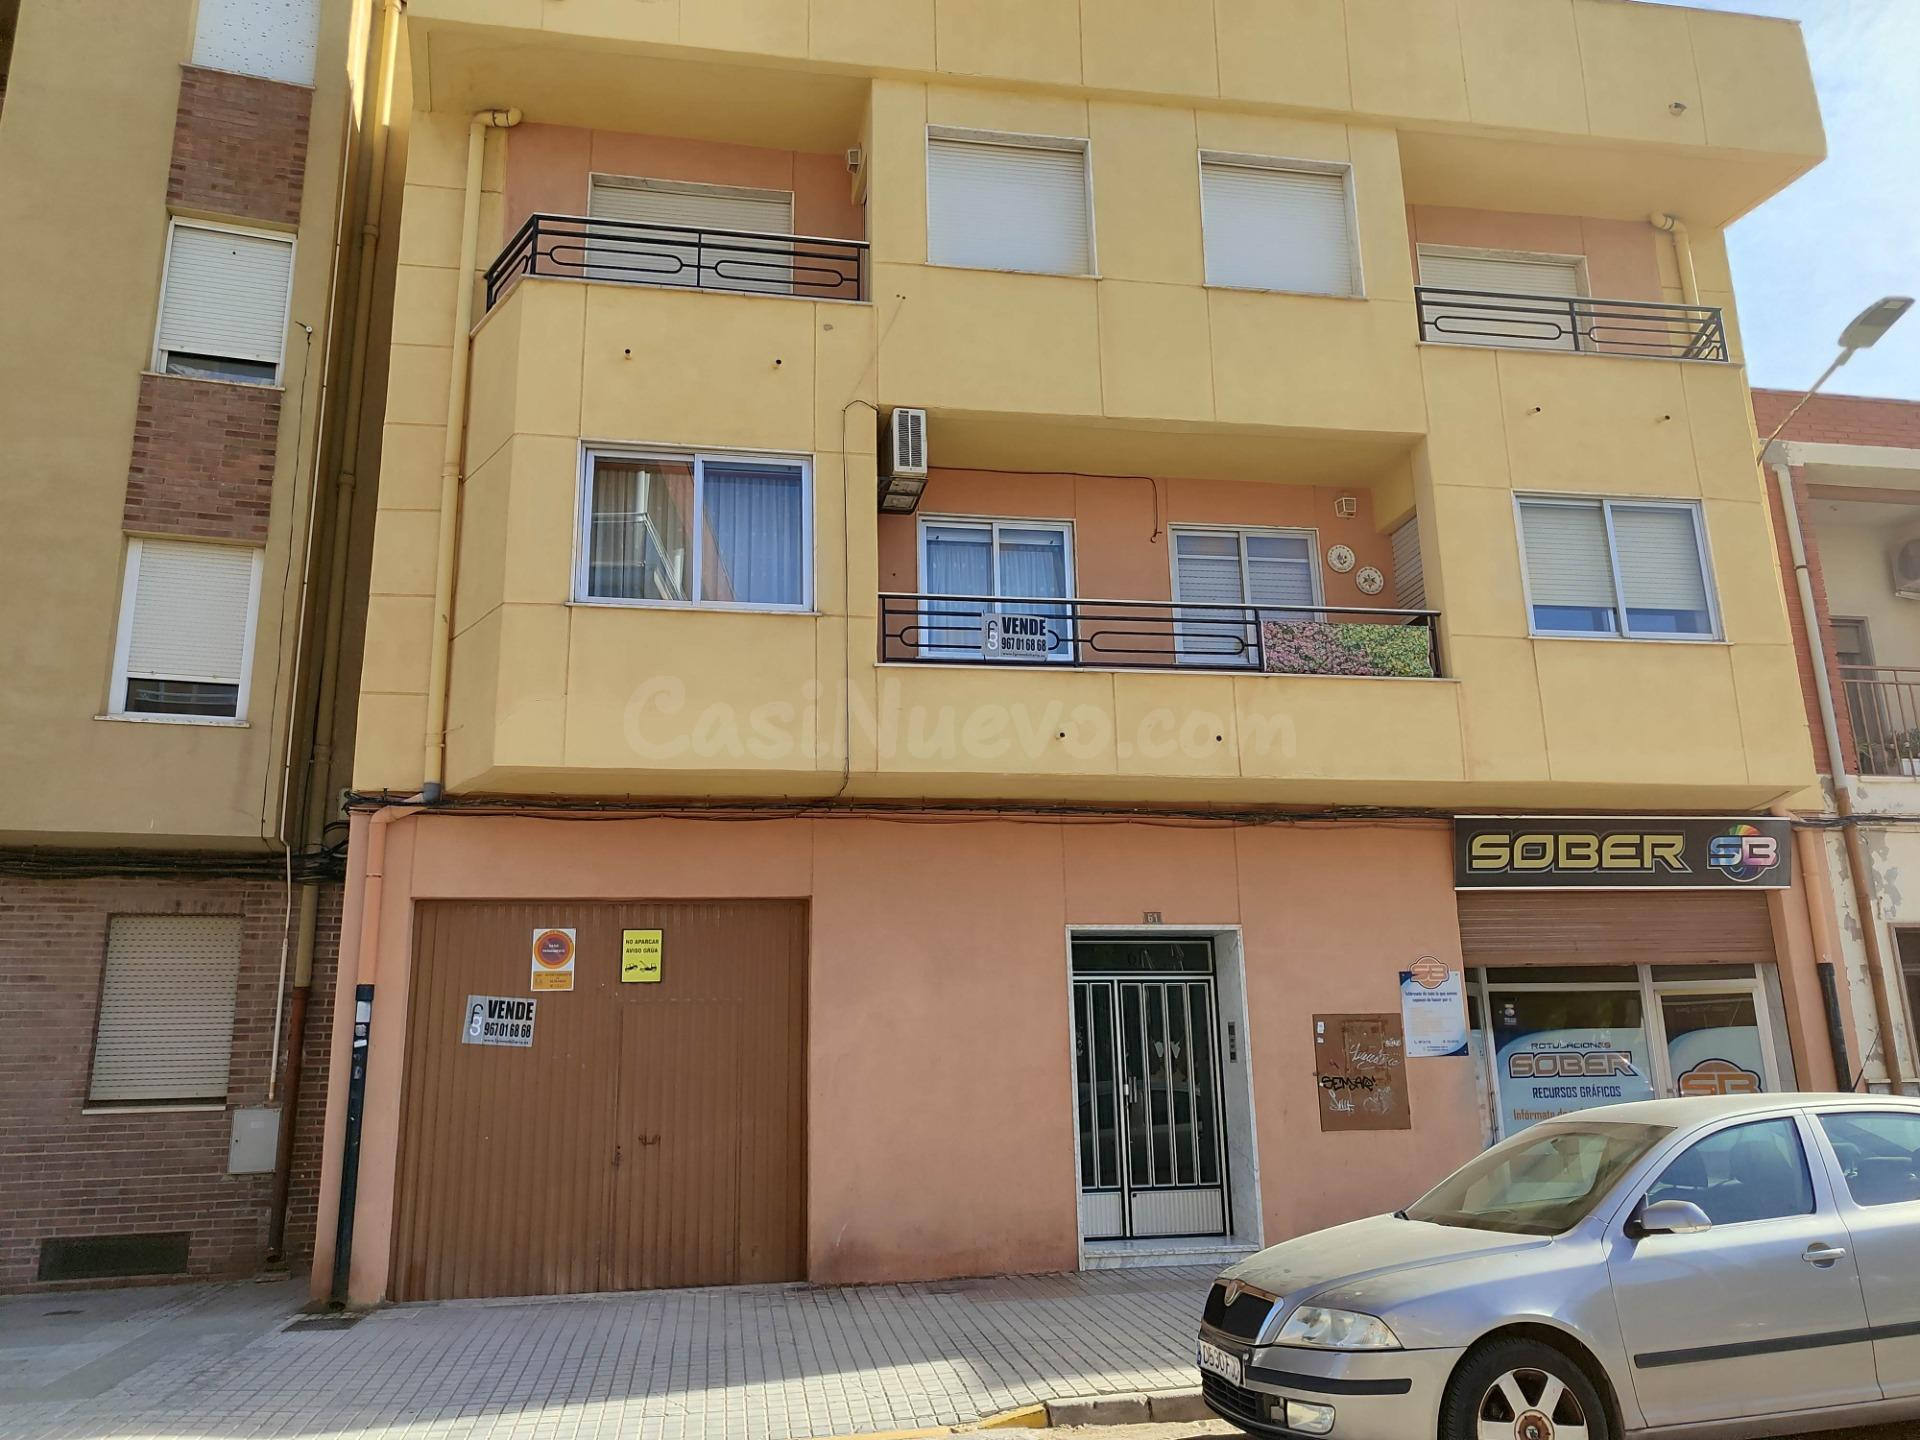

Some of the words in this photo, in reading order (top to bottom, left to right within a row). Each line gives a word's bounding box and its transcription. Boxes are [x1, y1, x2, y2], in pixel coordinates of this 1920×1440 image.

[1001, 616, 1046, 636] VENDE
[1001, 637, 1015, 650] 967
[1025, 638, 1036, 651] 68
[1036, 638, 1047, 652] 68
[1466, 831, 1694, 873] SOBER
[488, 999, 534, 1021] VENDE
[483, 1022, 499, 1036] 967
[509, 1023, 520, 1038] 68
[520, 1024, 532, 1039] 68
[1509, 1051, 1639, 1078] SOBER
[1532, 1086, 1578, 1099] RECURSOS
[1580, 1083, 1622, 1098] GRÁFICOS
